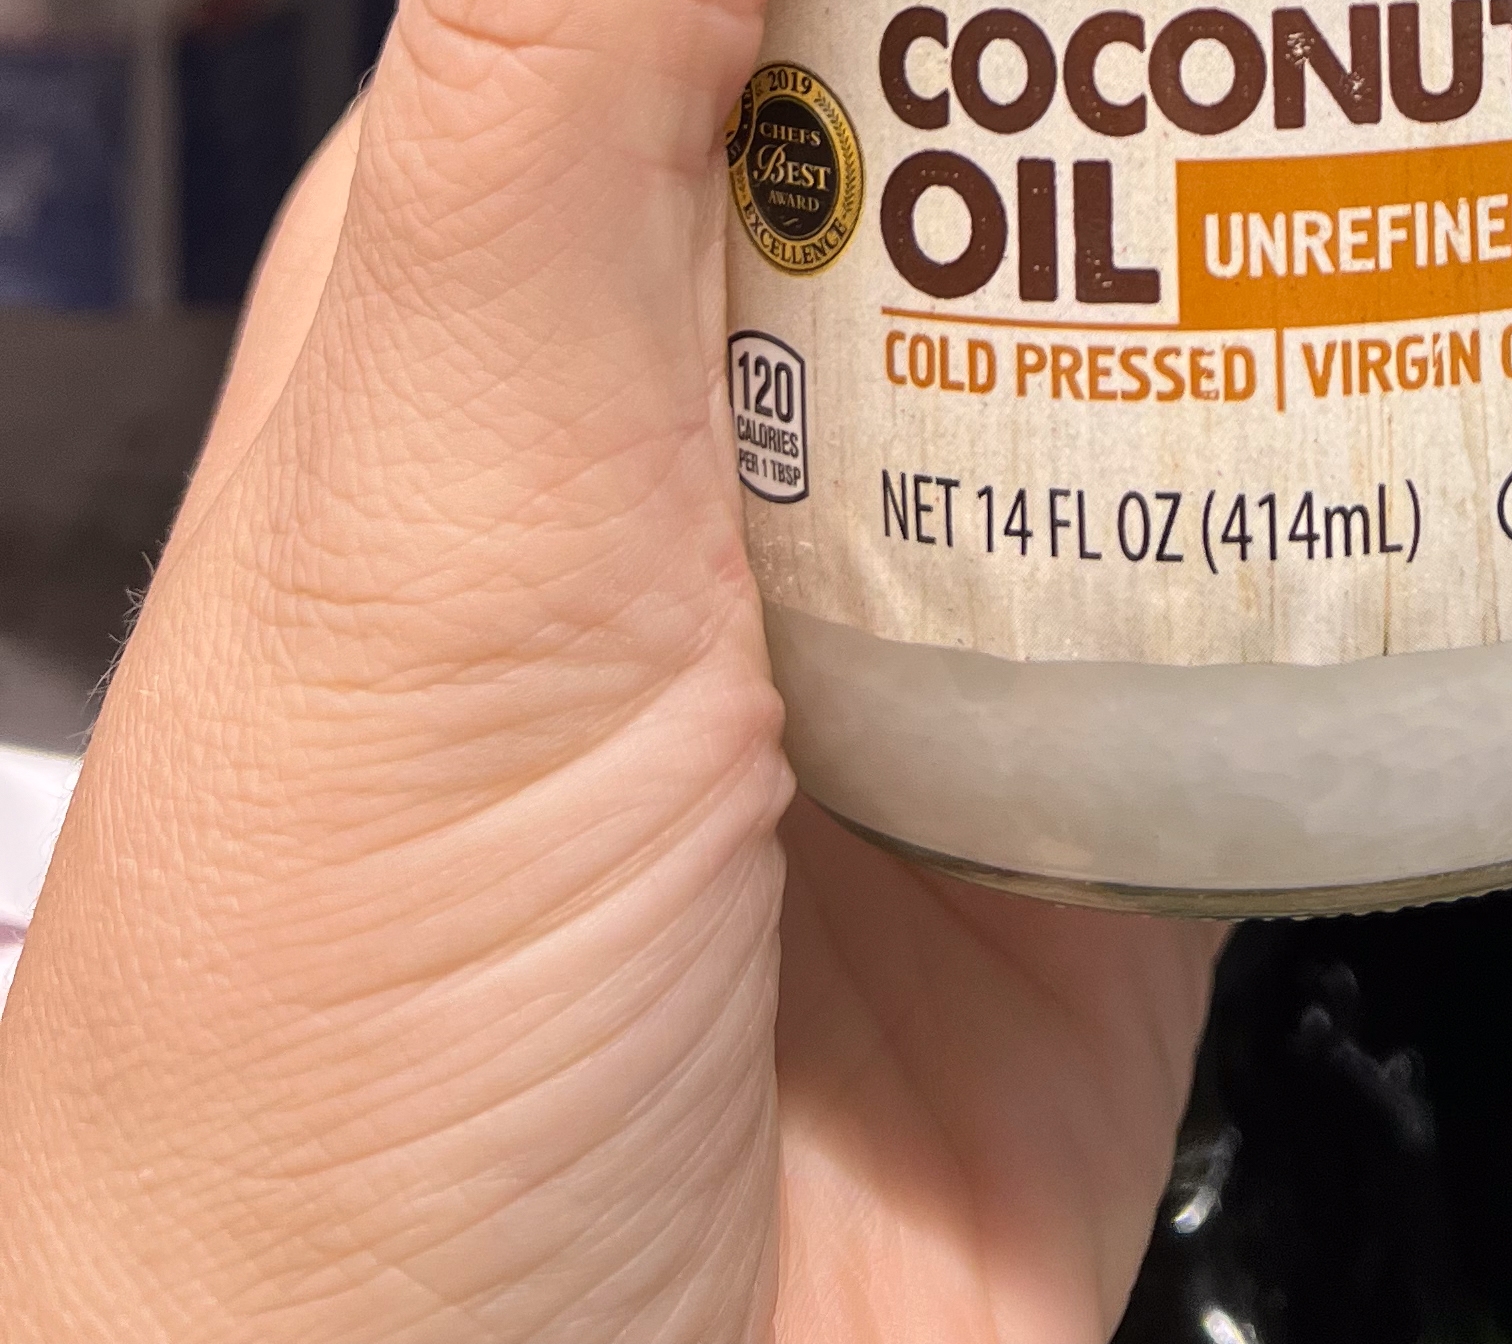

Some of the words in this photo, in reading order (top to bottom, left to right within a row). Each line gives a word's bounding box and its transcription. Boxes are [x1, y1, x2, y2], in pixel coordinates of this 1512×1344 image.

[767, 68, 814, 96] 2019
[768, 189, 820, 213] AWARD
[880, 148, 1162, 305] OIL
[743, 203, 847, 266] EXCELLENCE
[738, 351, 794, 424] 120
[884, 329, 997, 395] COLD
[1015, 342, 1257, 403] PRESSED
[1301, 328, 1482, 398] VIRGIN
[737, 413, 800, 459] CALORIES
[739, 447, 760, 477] PER
[770, 458, 801, 488] TBSP
[881, 468, 960, 548] NET
[976, 485, 1034, 558] 14
[1049, 488, 1102, 561] FL
[1116, 490, 1185, 564] OZ
[1201, 477, 1422, 575] (414mL)
